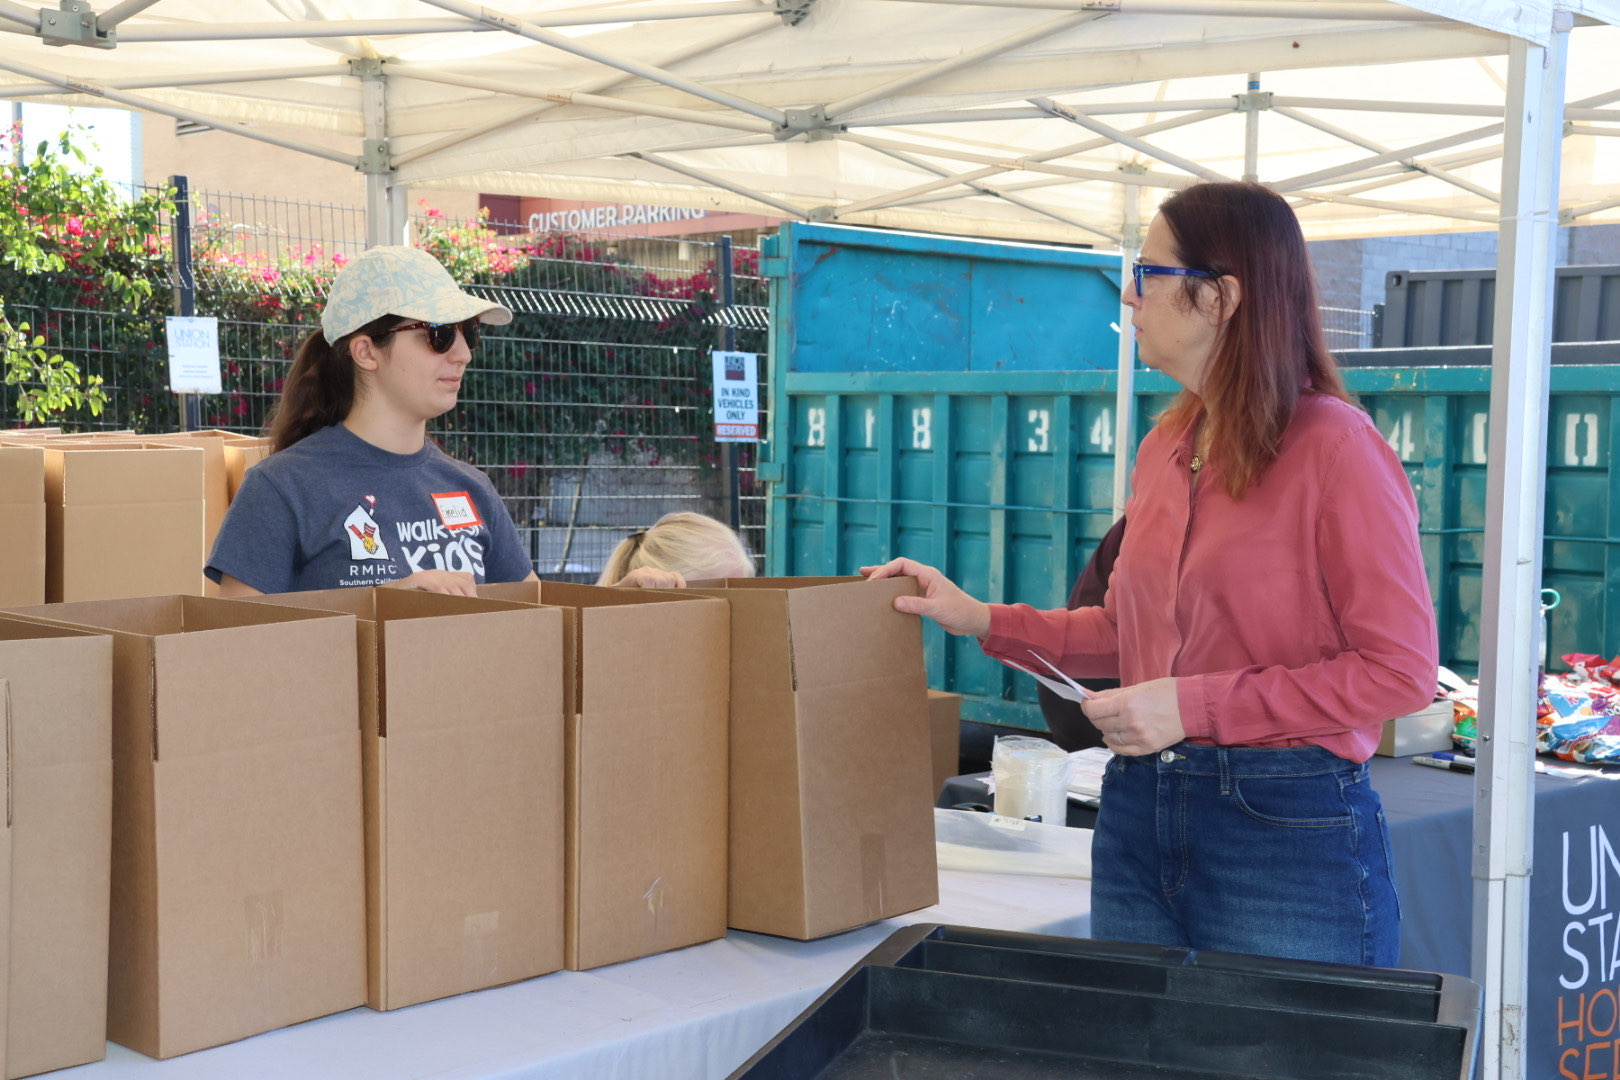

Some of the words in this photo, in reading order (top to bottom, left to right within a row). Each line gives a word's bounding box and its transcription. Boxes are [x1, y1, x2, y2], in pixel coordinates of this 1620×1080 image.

[529, 206, 618, 232] CUSTOMER
[174, 328, 209, 340] UNION
[721, 388, 729, 396] IN
[732, 388, 750, 397] KIND
[717, 399, 754, 409] VEHICLES
[726, 411, 745, 420] ONLY
[350, 564, 396, 576] RMHC
[375, 577, 401, 585] Calif
[1558, 988, 1620, 1046] HO
[1559, 1038, 1620, 1080] SE
